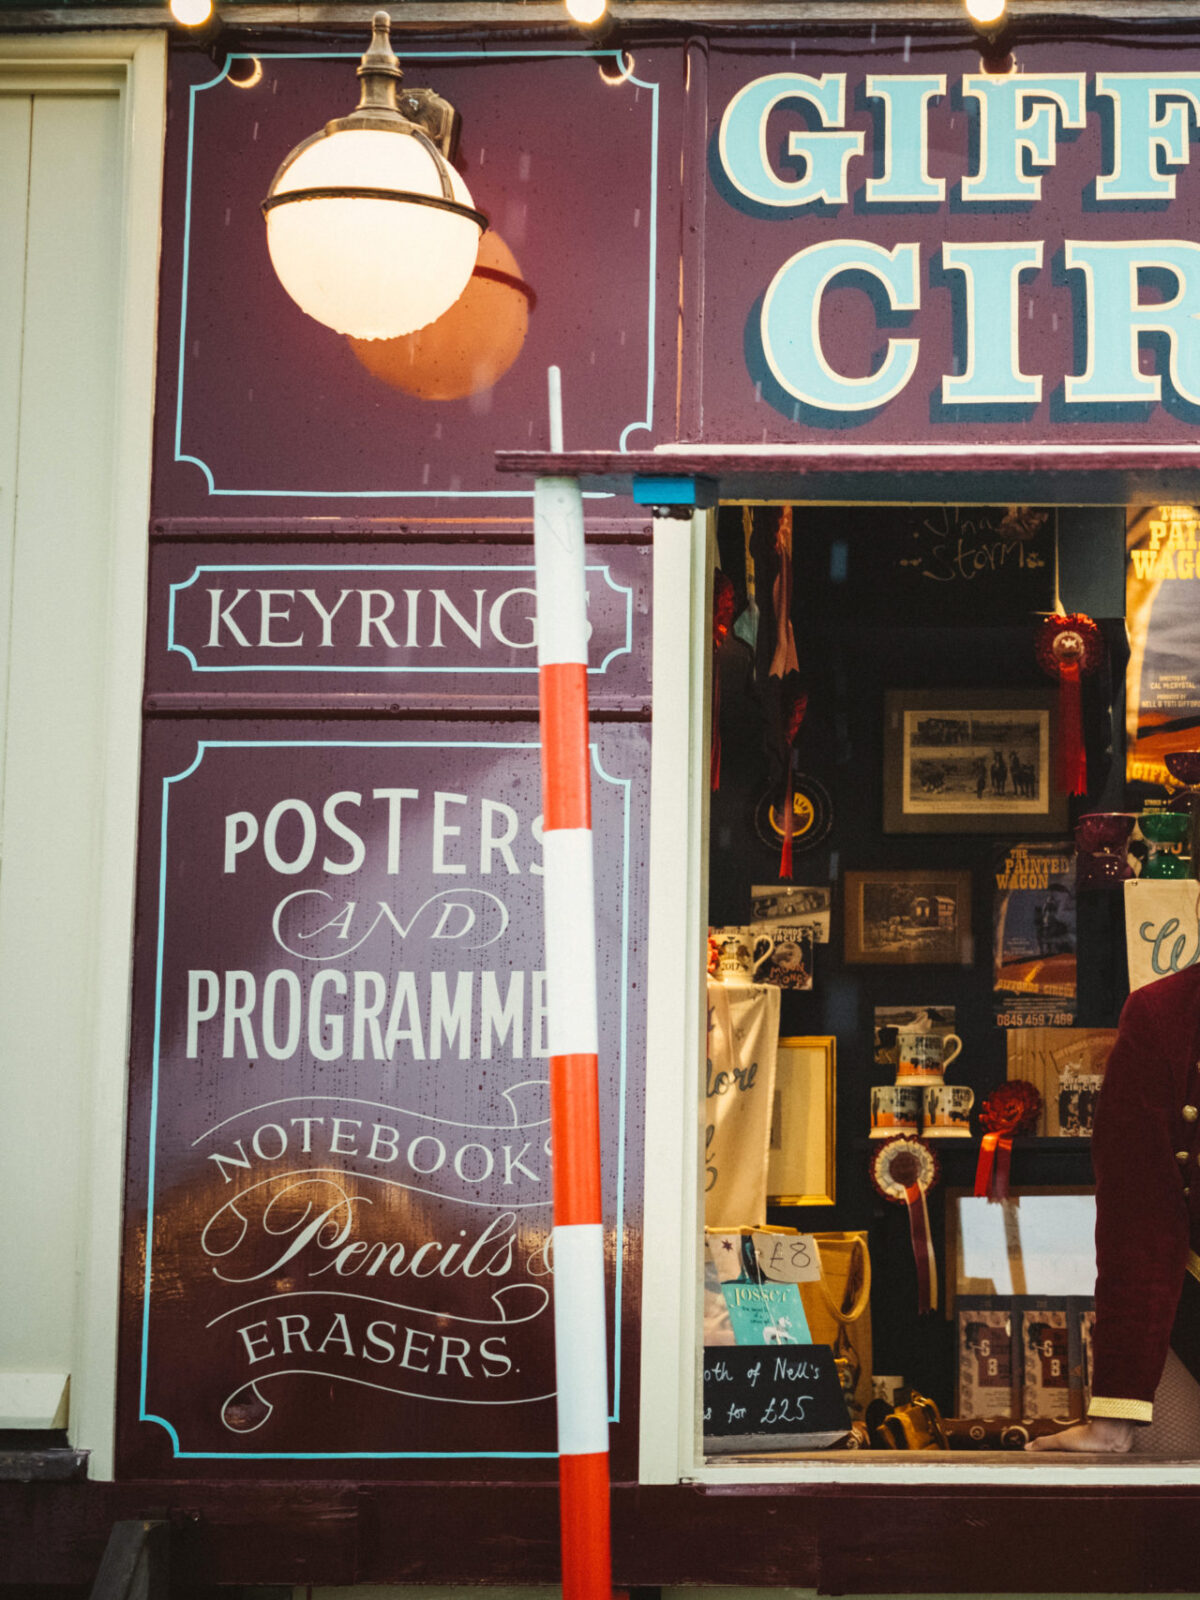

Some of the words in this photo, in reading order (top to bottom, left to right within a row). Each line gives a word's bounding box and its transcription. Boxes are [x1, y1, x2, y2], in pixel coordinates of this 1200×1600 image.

[203, 587, 593, 649] KEYRING
[996, 874, 1049, 890] WAGON
[1004, 859, 1069, 874] PAINTED
[186, 969, 549, 1060] PROGRAMME
[207, 1116, 554, 1185] NOTEBOOK
[211, 1178, 517, 1283] Pencils
[769, 1241, 811, 1272] £8
[236, 1312, 521, 1378] ERASERS.
[704, 1361, 734, 1382] oth
[746, 1361, 762, 1388] of
[773, 1356, 820, 1382] Nell's
[727, 1402, 748, 1424] for
[759, 1395, 814, 1424] £25
